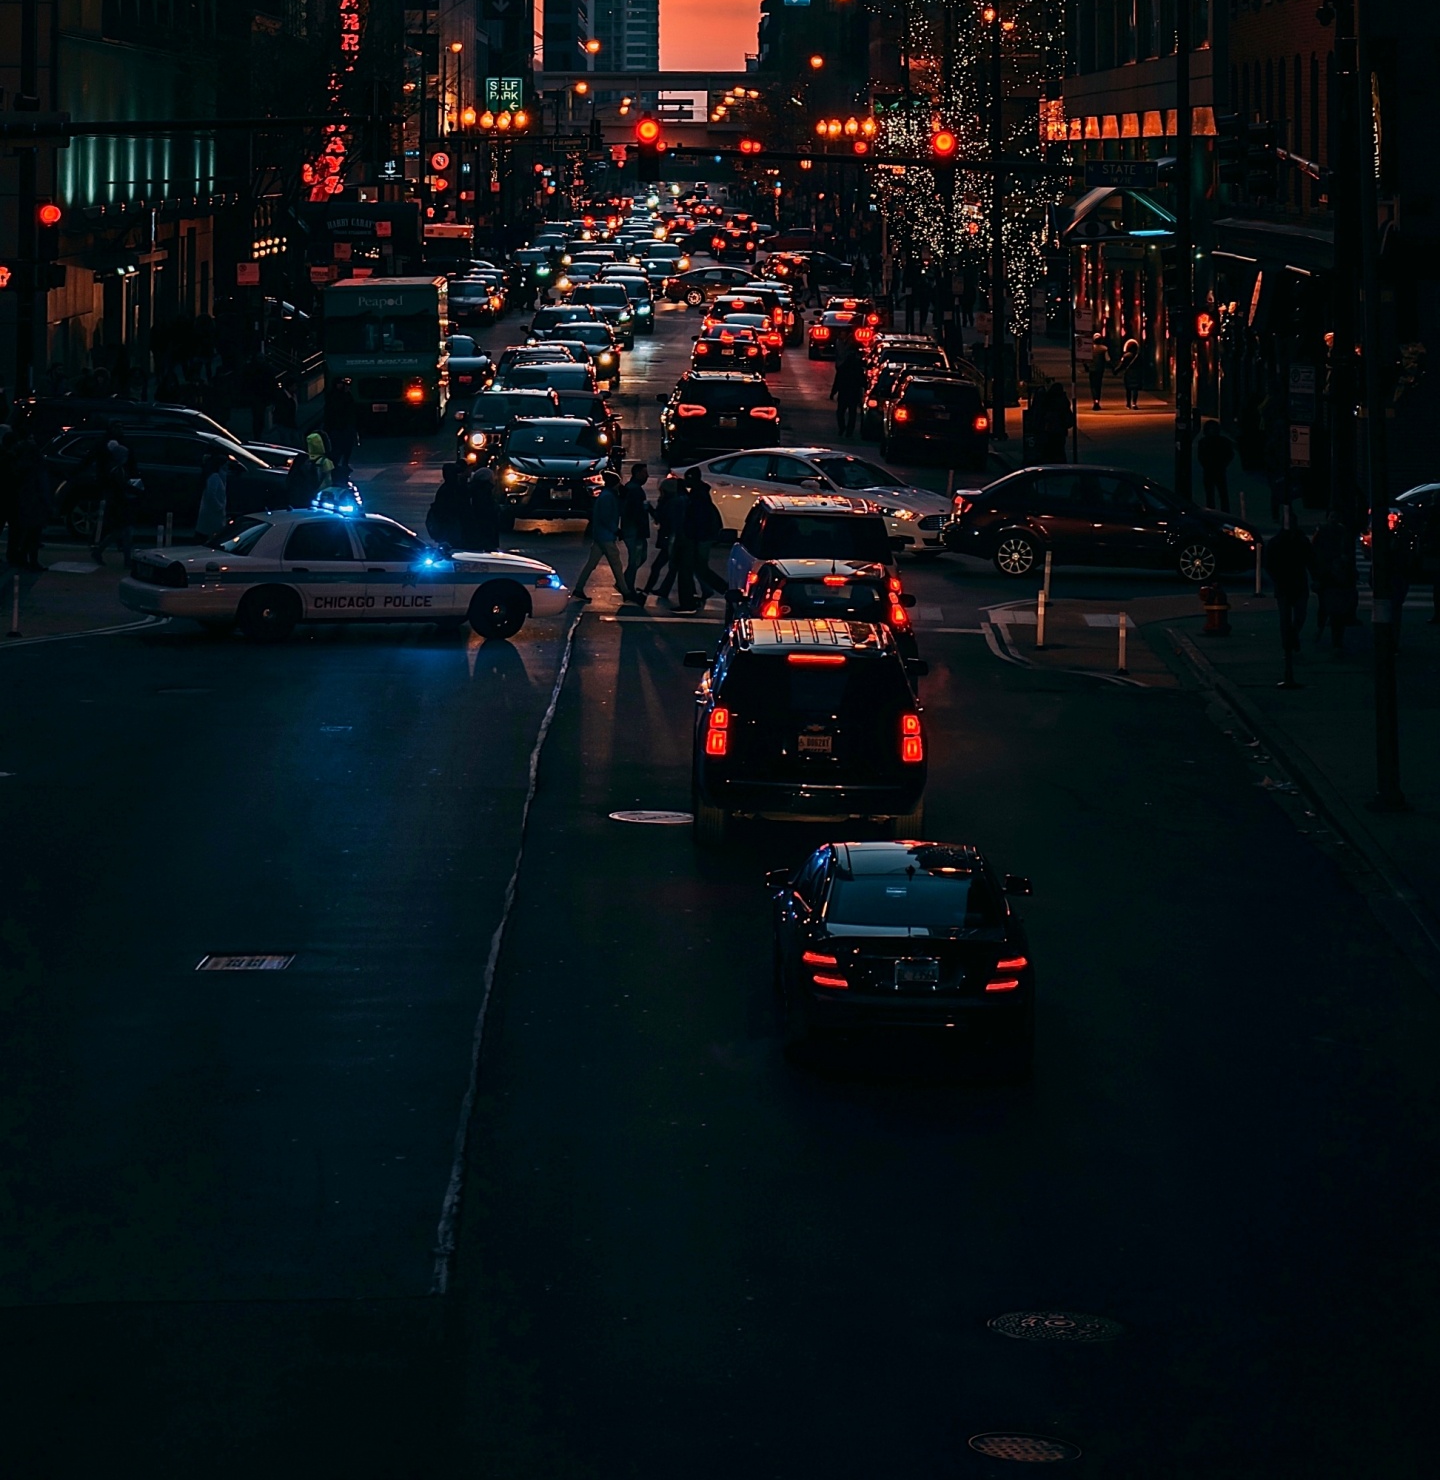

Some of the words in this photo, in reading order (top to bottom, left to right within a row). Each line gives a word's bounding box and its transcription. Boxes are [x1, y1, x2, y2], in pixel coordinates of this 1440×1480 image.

[490, 81, 518, 91] SELF
[490, 91, 519, 101] PARK
[1102, 164, 1136, 175] STATE
[358, 296, 403, 309] Peapod
[314, 597, 375, 609] CHICAGO
[384, 595, 432, 608] POLICE
